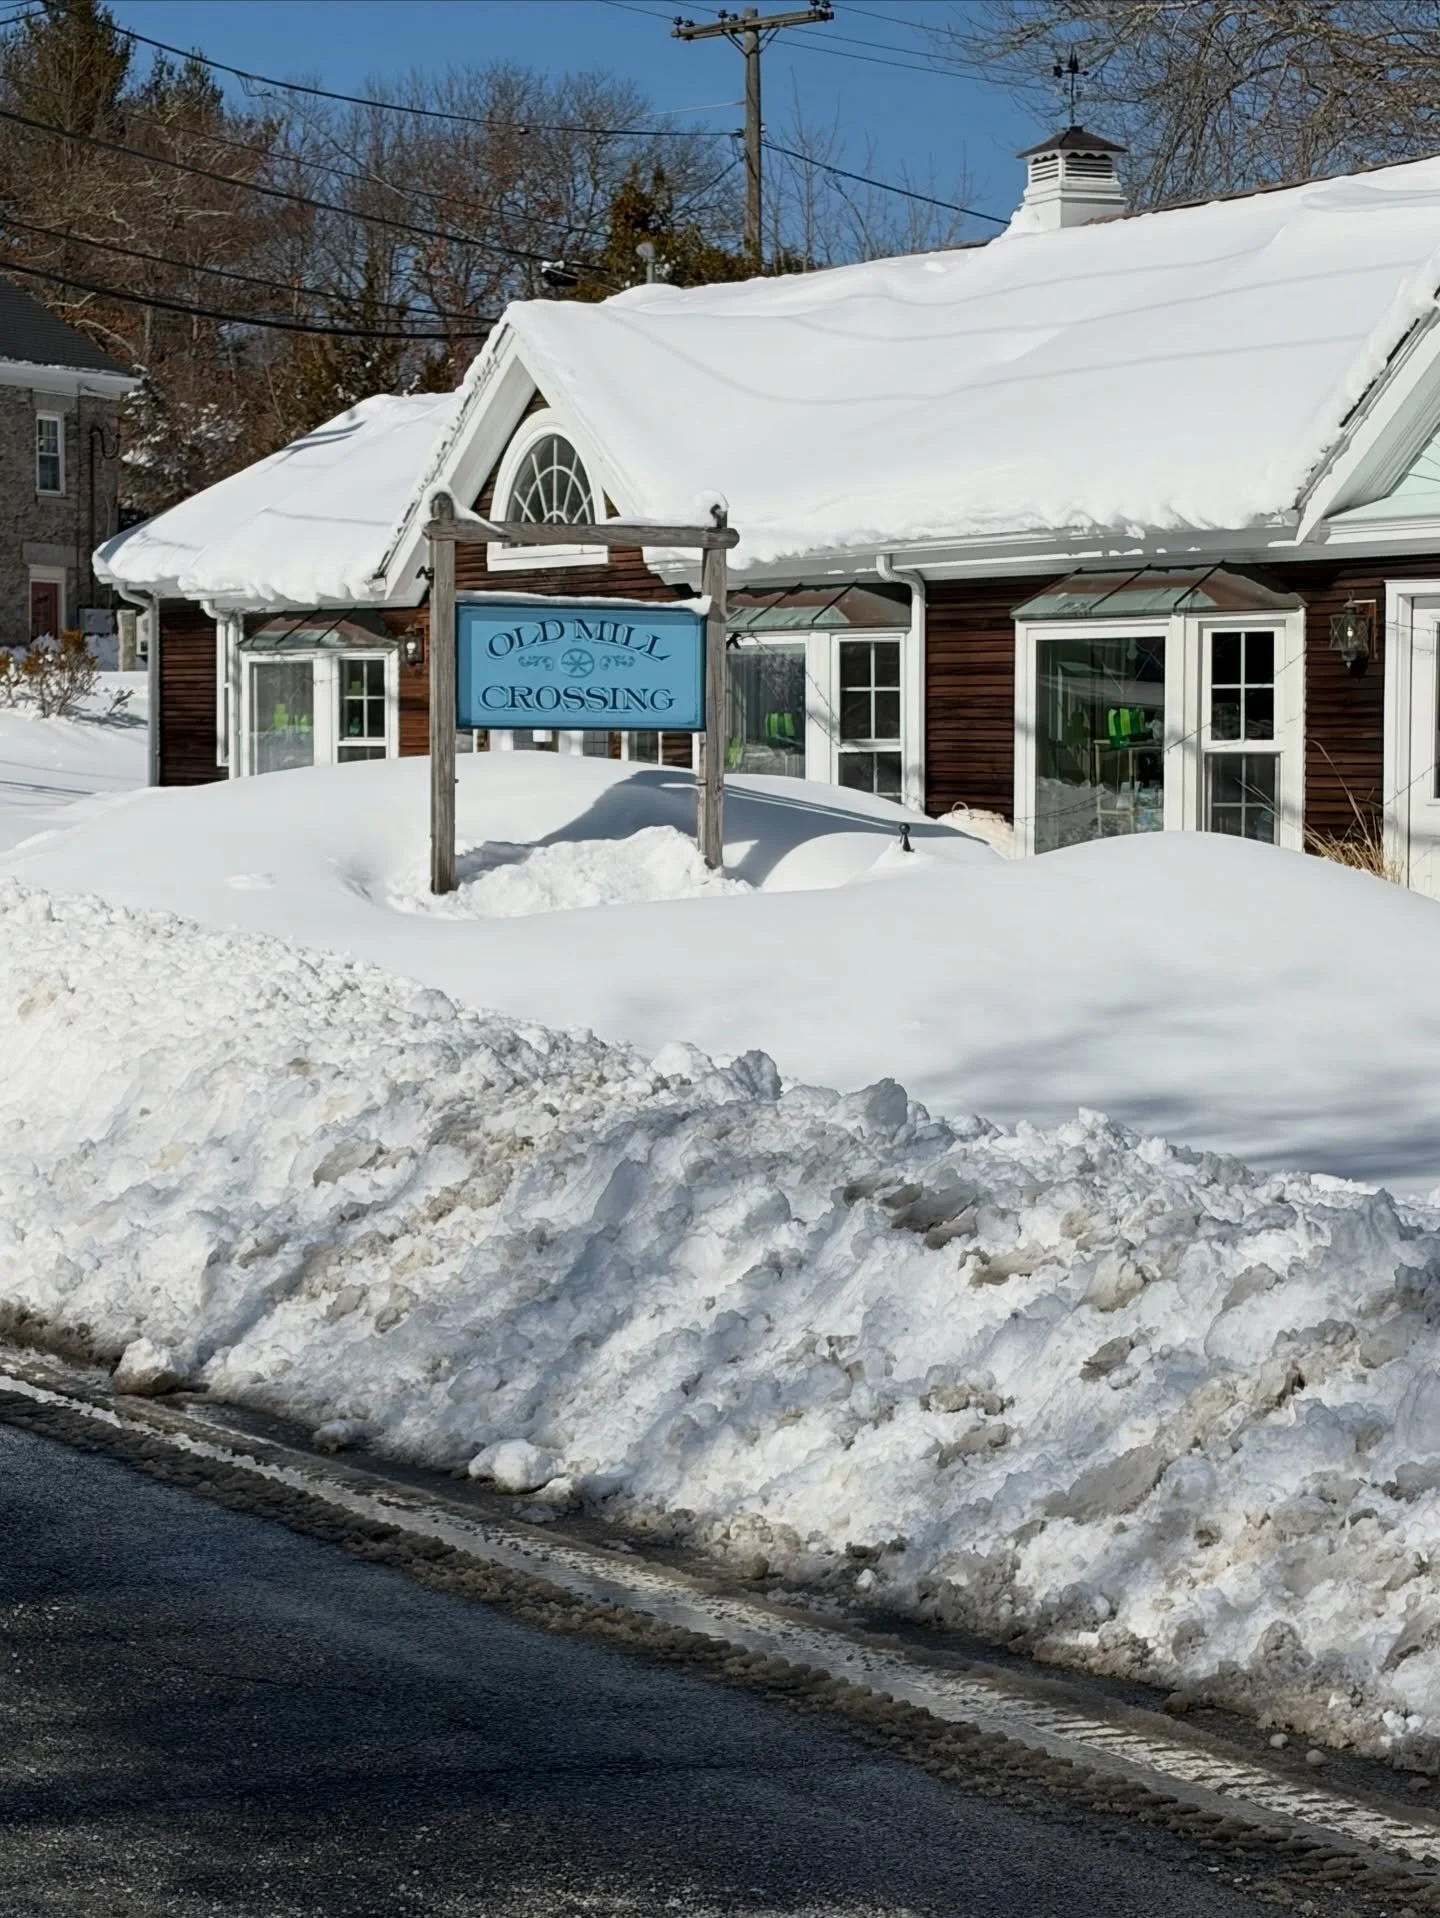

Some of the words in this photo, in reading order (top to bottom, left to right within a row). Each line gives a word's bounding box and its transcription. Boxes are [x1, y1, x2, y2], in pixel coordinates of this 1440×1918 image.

[487, 619, 565, 659] OLD
[572, 618, 671, 661] MILL
[480, 685, 677, 712] CROSSING
